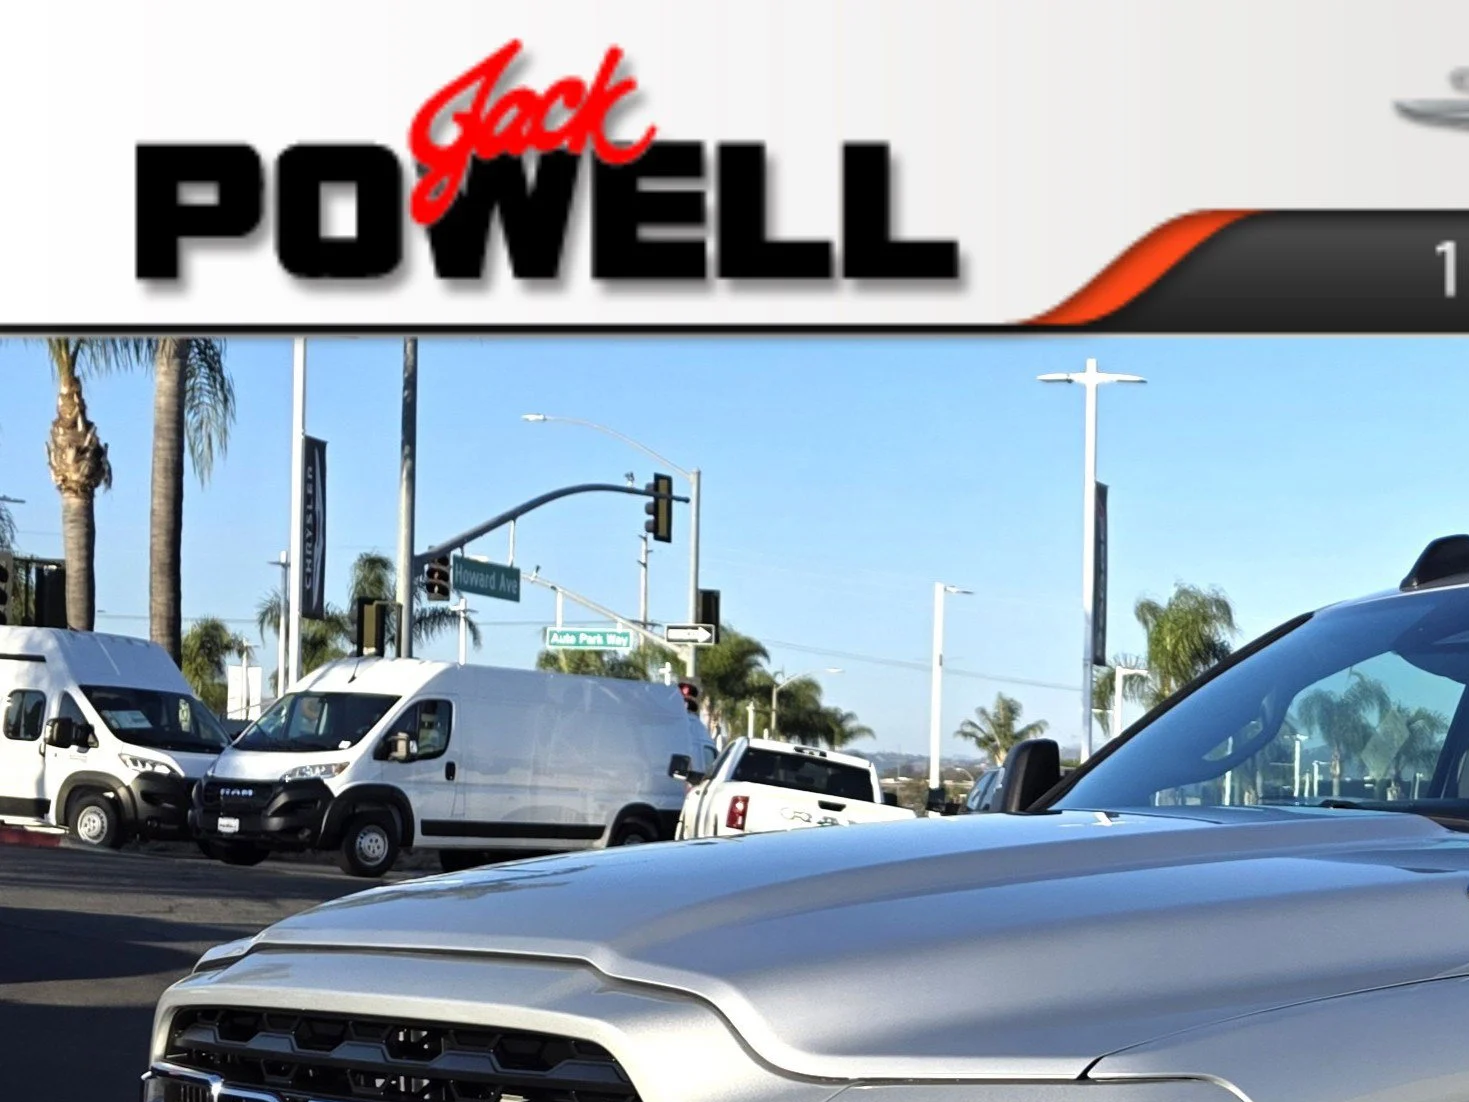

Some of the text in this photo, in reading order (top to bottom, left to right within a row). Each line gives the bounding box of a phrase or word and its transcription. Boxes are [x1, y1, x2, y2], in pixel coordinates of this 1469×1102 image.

[304, 465, 314, 590] CHRYSLER
[454, 562, 519, 595] Howard Ave
[550, 632, 629, 648] Auto Park Way
[219, 788, 254, 797] RAM
